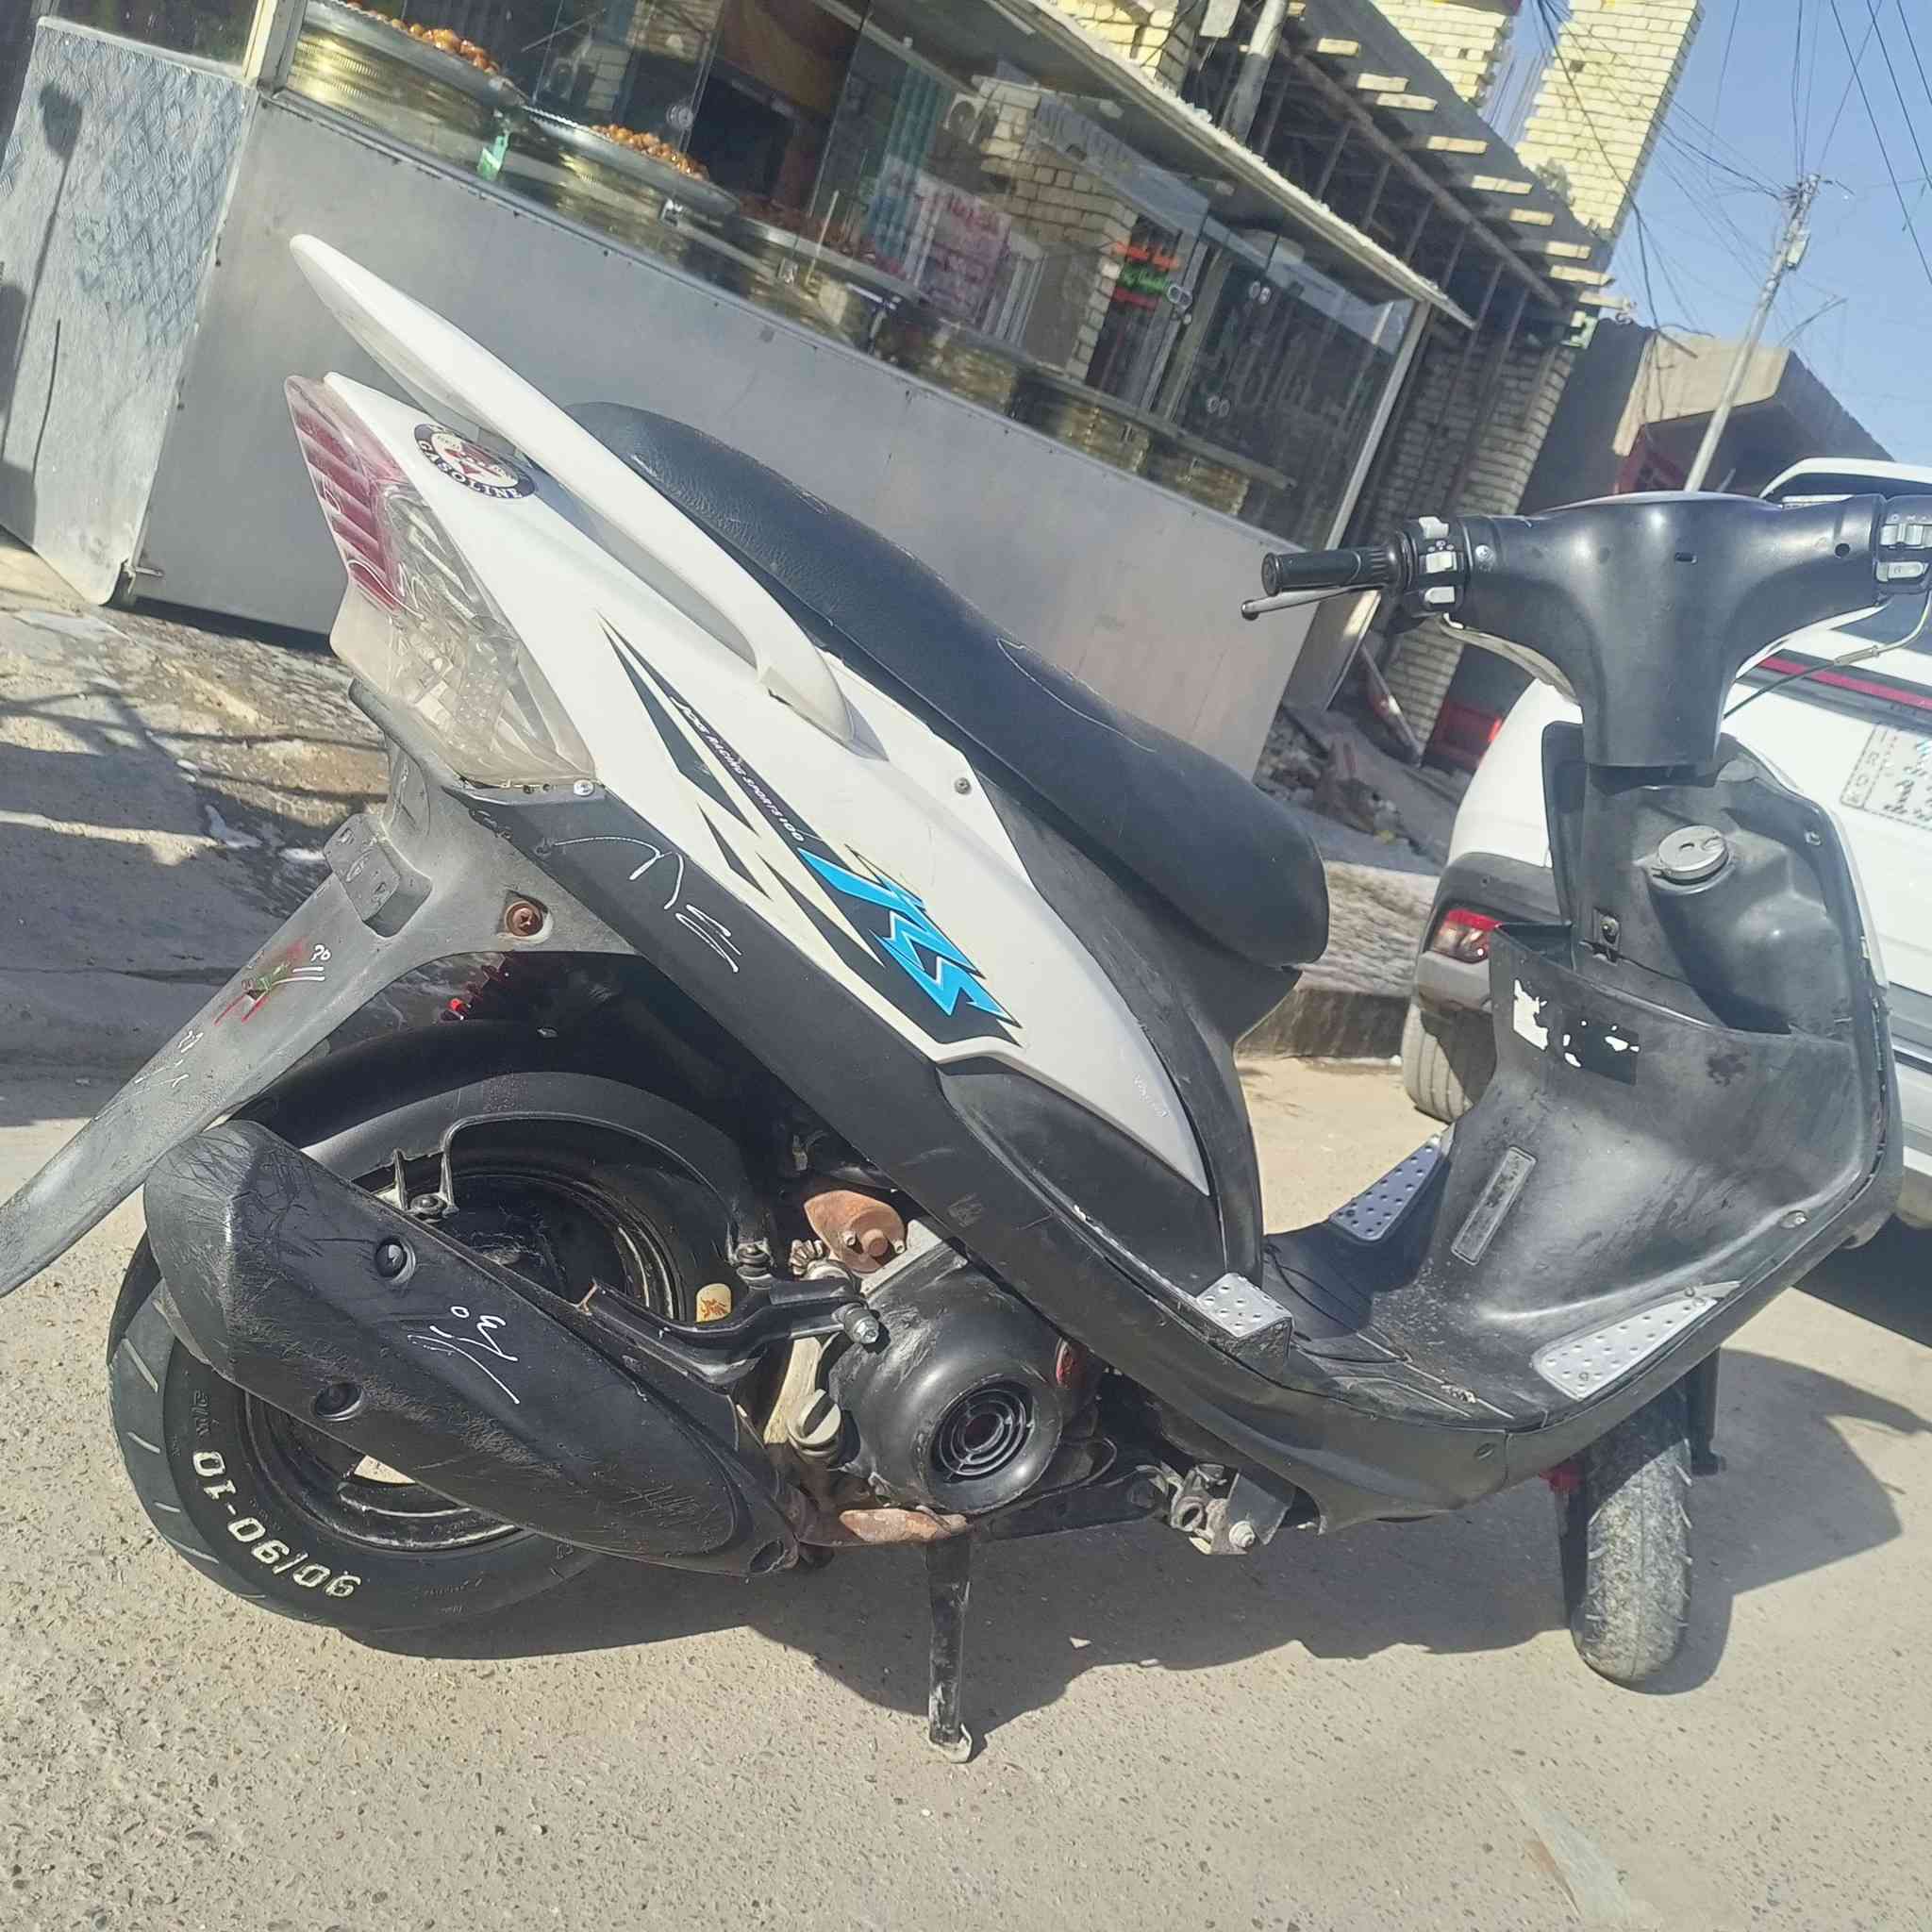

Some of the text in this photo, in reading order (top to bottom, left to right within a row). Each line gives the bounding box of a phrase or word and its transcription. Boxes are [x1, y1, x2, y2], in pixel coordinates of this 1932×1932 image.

[418, 440, 523, 498] GASOLINE
[706, 735, 747, 776] RACING
[742, 775, 784, 818] SPORTS
[778, 817, 805, 842] 100
[192, 1451, 362, 1597] 90/90-10
